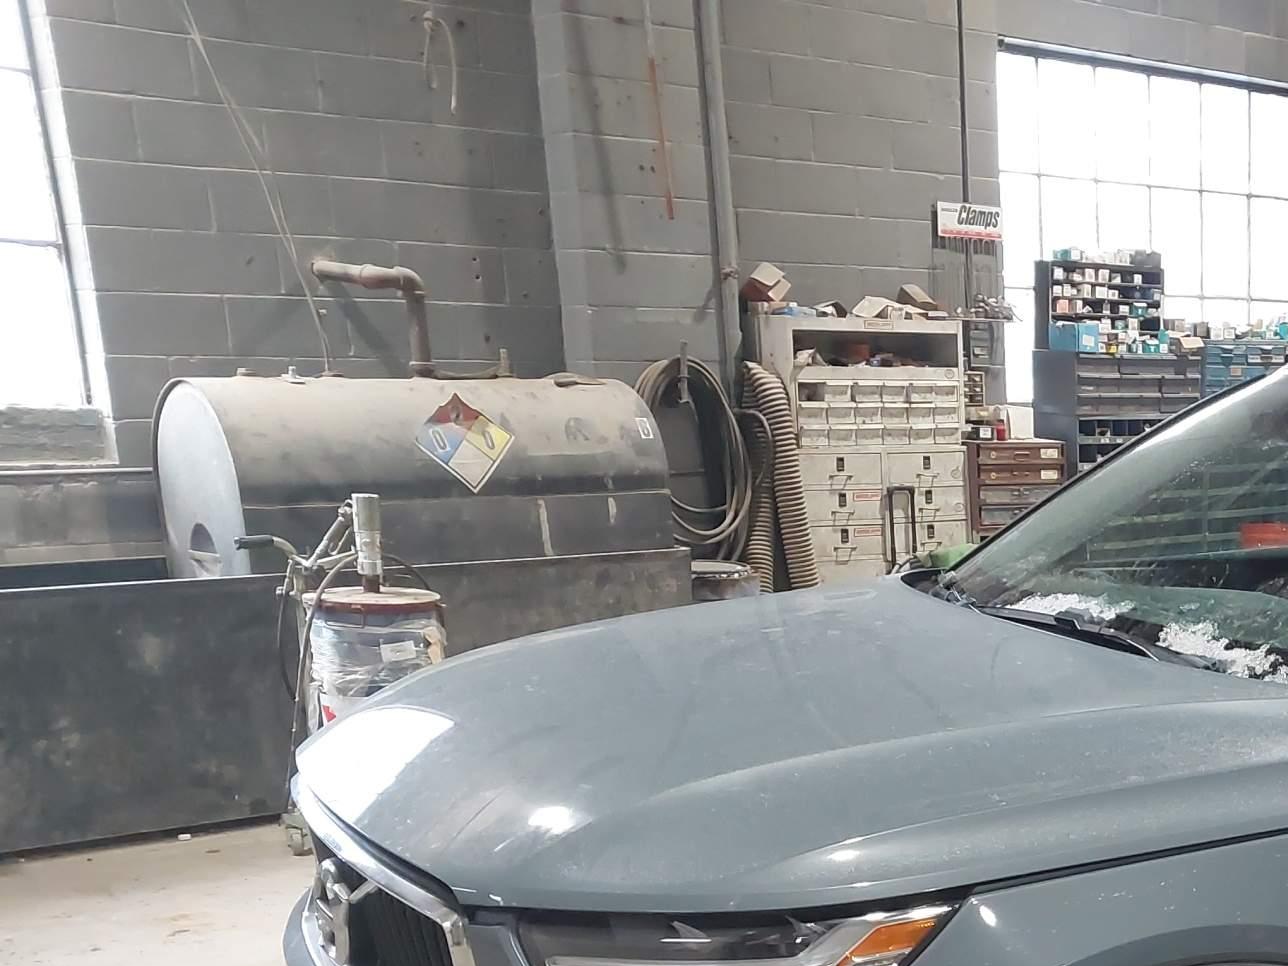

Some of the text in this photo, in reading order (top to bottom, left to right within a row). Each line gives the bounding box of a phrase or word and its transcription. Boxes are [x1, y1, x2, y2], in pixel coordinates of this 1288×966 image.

[957, 204, 1000, 230] Clamps
[429, 427, 448, 452] 0
[481, 430, 496, 450] 0
